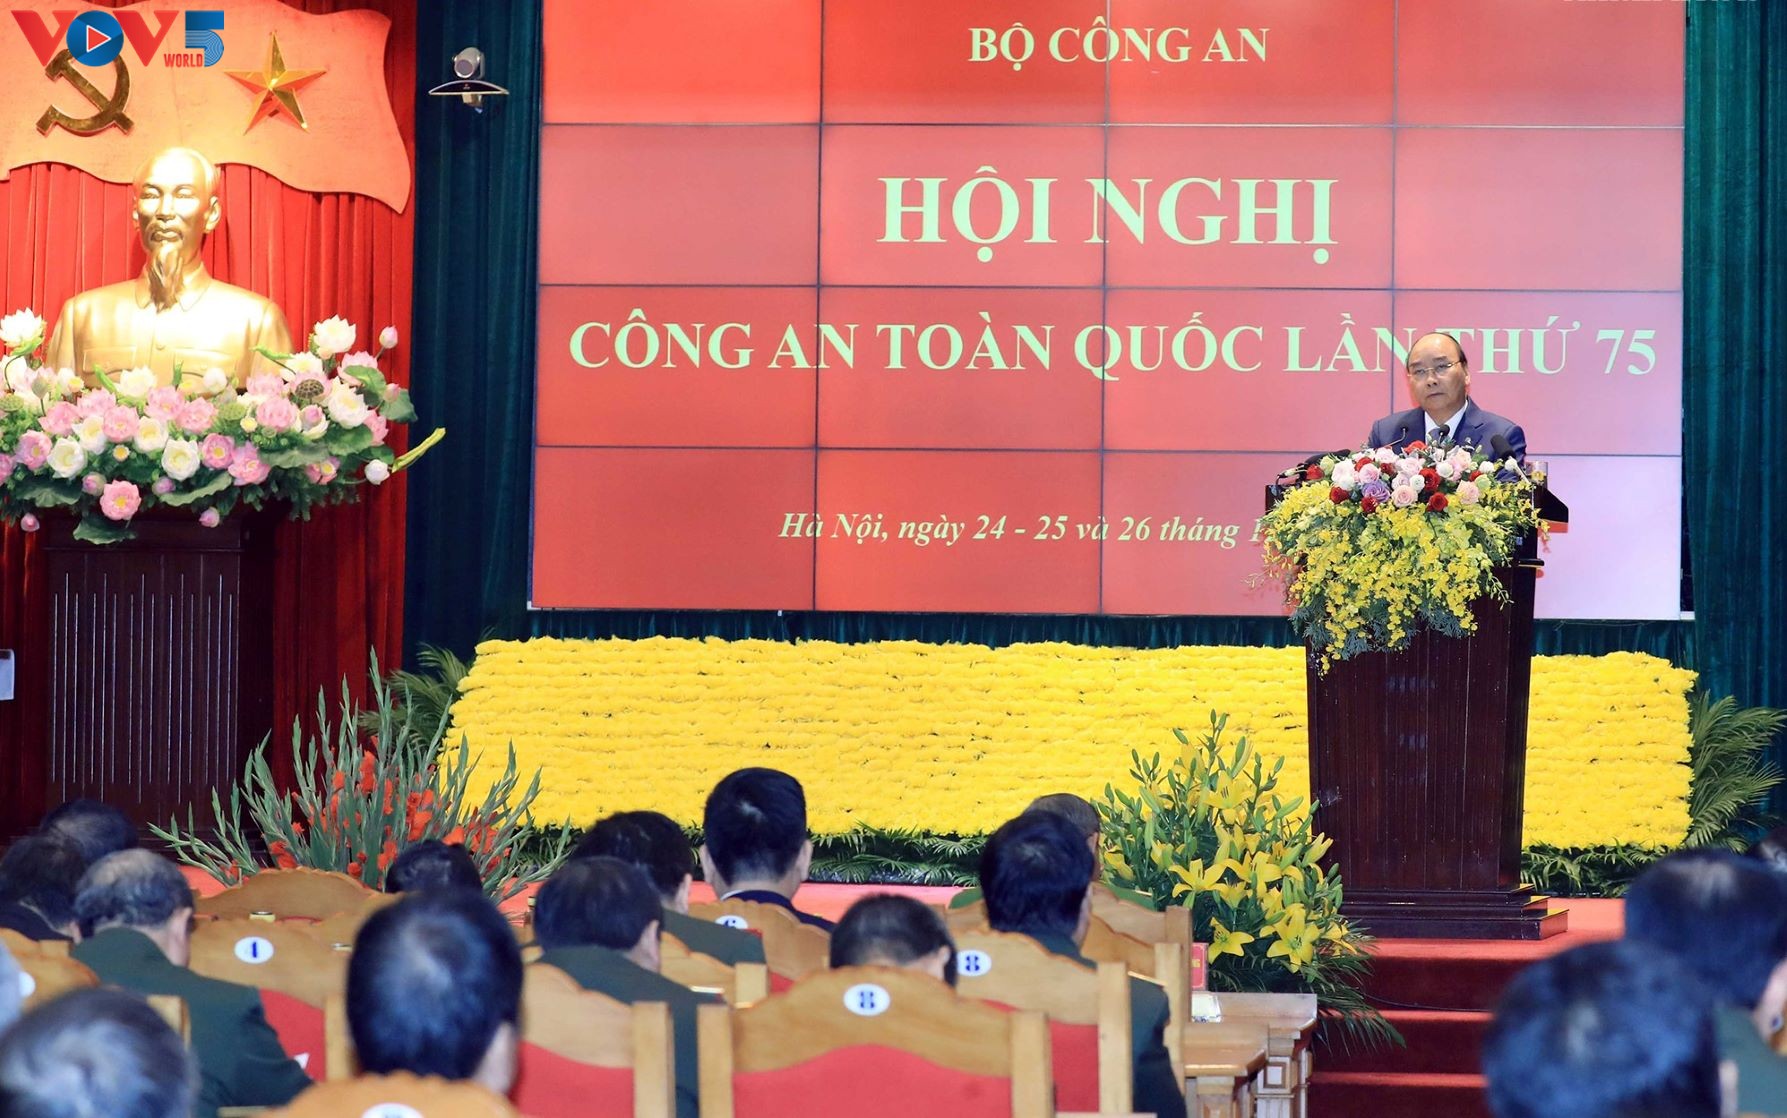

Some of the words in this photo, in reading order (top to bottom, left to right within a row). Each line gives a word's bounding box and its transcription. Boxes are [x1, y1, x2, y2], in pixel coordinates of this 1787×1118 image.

[967, 22, 1035, 72] BỘ
[1048, 15, 1193, 63] CÔNG
[1201, 27, 1270, 63] AN
[876, 165, 1058, 263] HỘI
[1084, 177, 1339, 265] NGHỊ
[569, 308, 755, 369] CÔNG
[767, 323, 860, 370] AN
[876, 311, 1055, 371] TOÀN
[1073, 312, 1264, 382] QUỐC
[1282, 313, 1418, 372] LẦN
[1595, 329, 1657, 376] 75
[778, 513, 824, 538] Hà
[830, 513, 889, 545] Nội,
[897, 514, 965, 547] ngày
[972, 514, 1007, 540] 24
[1014, 527, 1026, 535] -
[1033, 515, 1069, 540] 25
[1076, 516, 1109, 541] và
[1117, 516, 1152, 542] 26
[1158, 516, 1240, 549] tháng
[965, 954, 980, 972] 8
